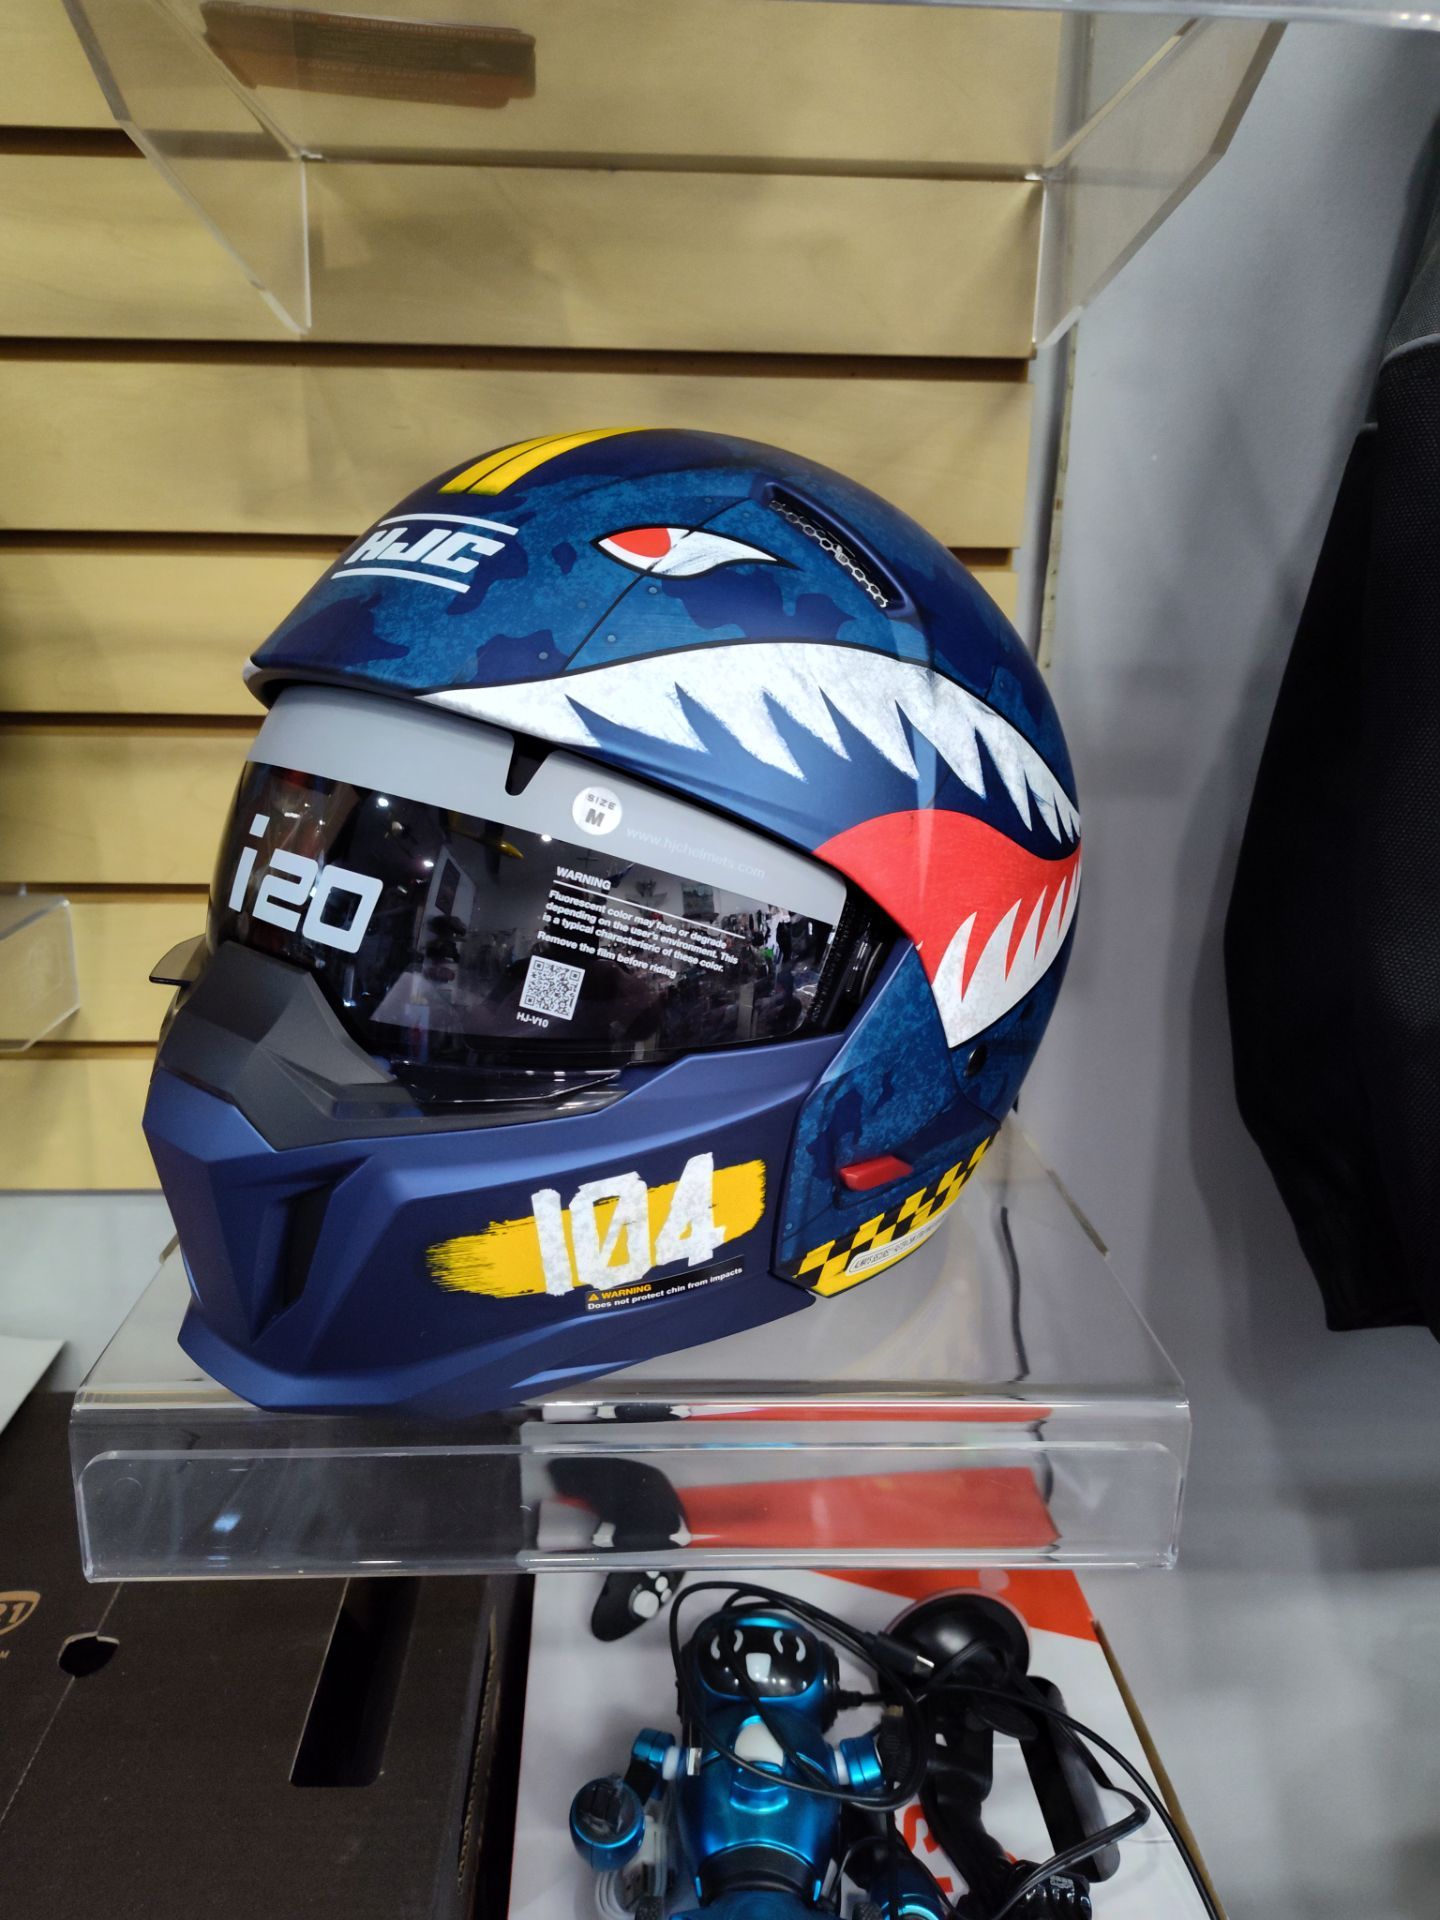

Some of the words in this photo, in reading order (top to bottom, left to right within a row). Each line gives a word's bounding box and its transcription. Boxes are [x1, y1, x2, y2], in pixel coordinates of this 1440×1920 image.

[344, 527, 505, 573] HJC
[585, 793, 616, 811] SIZE
[585, 808, 605, 827] M
[556, 866, 612, 891] WARNING
[545, 902, 598, 924] depending
[598, 918, 611, 927] on
[613, 921, 629, 932] the
[630, 926, 659, 941] user's
[660, 936, 719, 959] environment.
[720, 952, 739, 965] This
[549, 889, 607, 914] Fluorescent
[607, 908, 634, 921] color
[634, 916, 656, 929] may
[656, 921, 677, 935] fade
[678, 929, 690, 938] or
[690, 932, 728, 950] degrade
[536, 930, 579, 949] Remove
[579, 942, 596, 955] the
[597, 947, 616, 961] film
[616, 953, 649, 969] before
[649, 963, 678, 980] riding
[542, 912, 552, 922] is
[552, 917, 561, 925] a
[561, 918, 595, 935] typical
[662, 948, 673, 957] of
[673, 950, 699, 965] these
[699, 960, 724, 973] color.
[516, 1011, 549, 1028] HJ-V10
[531, 1152, 726, 1296] 104
[587, 1301, 612, 1310] Does
[614, 1298, 629, 1306] not
[631, 1290, 665, 1304] protect
[666, 1285, 685, 1295] chin
[687, 1279, 708, 1289] from
[709, 1267, 743, 1283] impacts
[601, 1284, 652, 1300] WARNING
